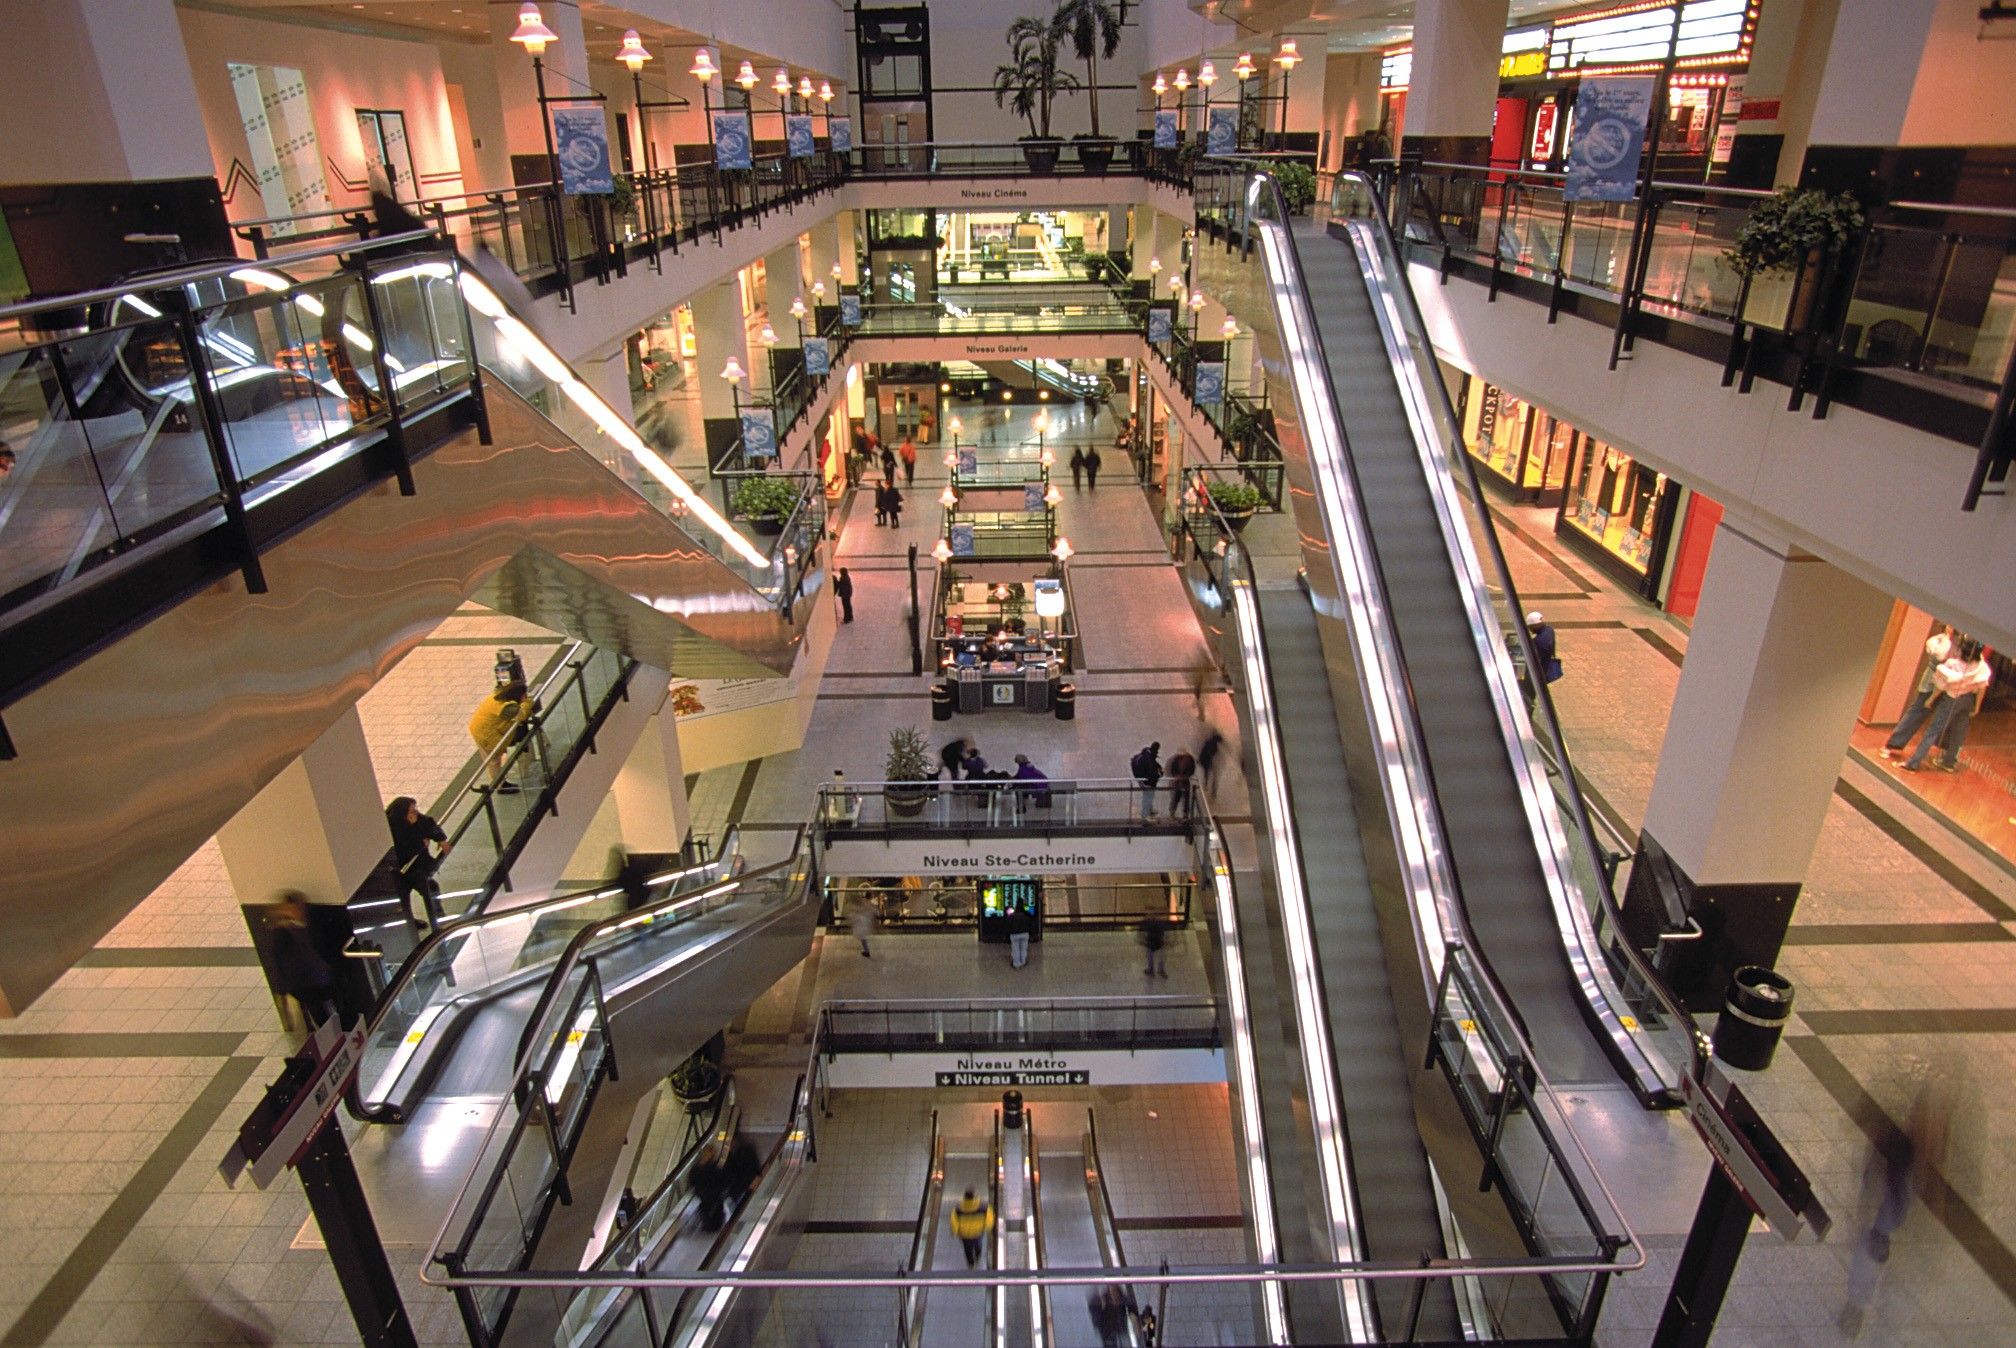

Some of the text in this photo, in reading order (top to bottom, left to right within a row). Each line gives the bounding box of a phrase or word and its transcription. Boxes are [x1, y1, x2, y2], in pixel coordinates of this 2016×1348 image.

[961, 189, 1027, 198] Niveau Cinéma
[998, 345, 1028, 353] Galerie
[923, 853, 1096, 867] Niveau Ste-Catherine
[957, 1058, 1067, 1070] Niveau Métro
[955, 1072, 1070, 1085] Niveau Tunnel
[1696, 1103, 1731, 1155] Cinéma
